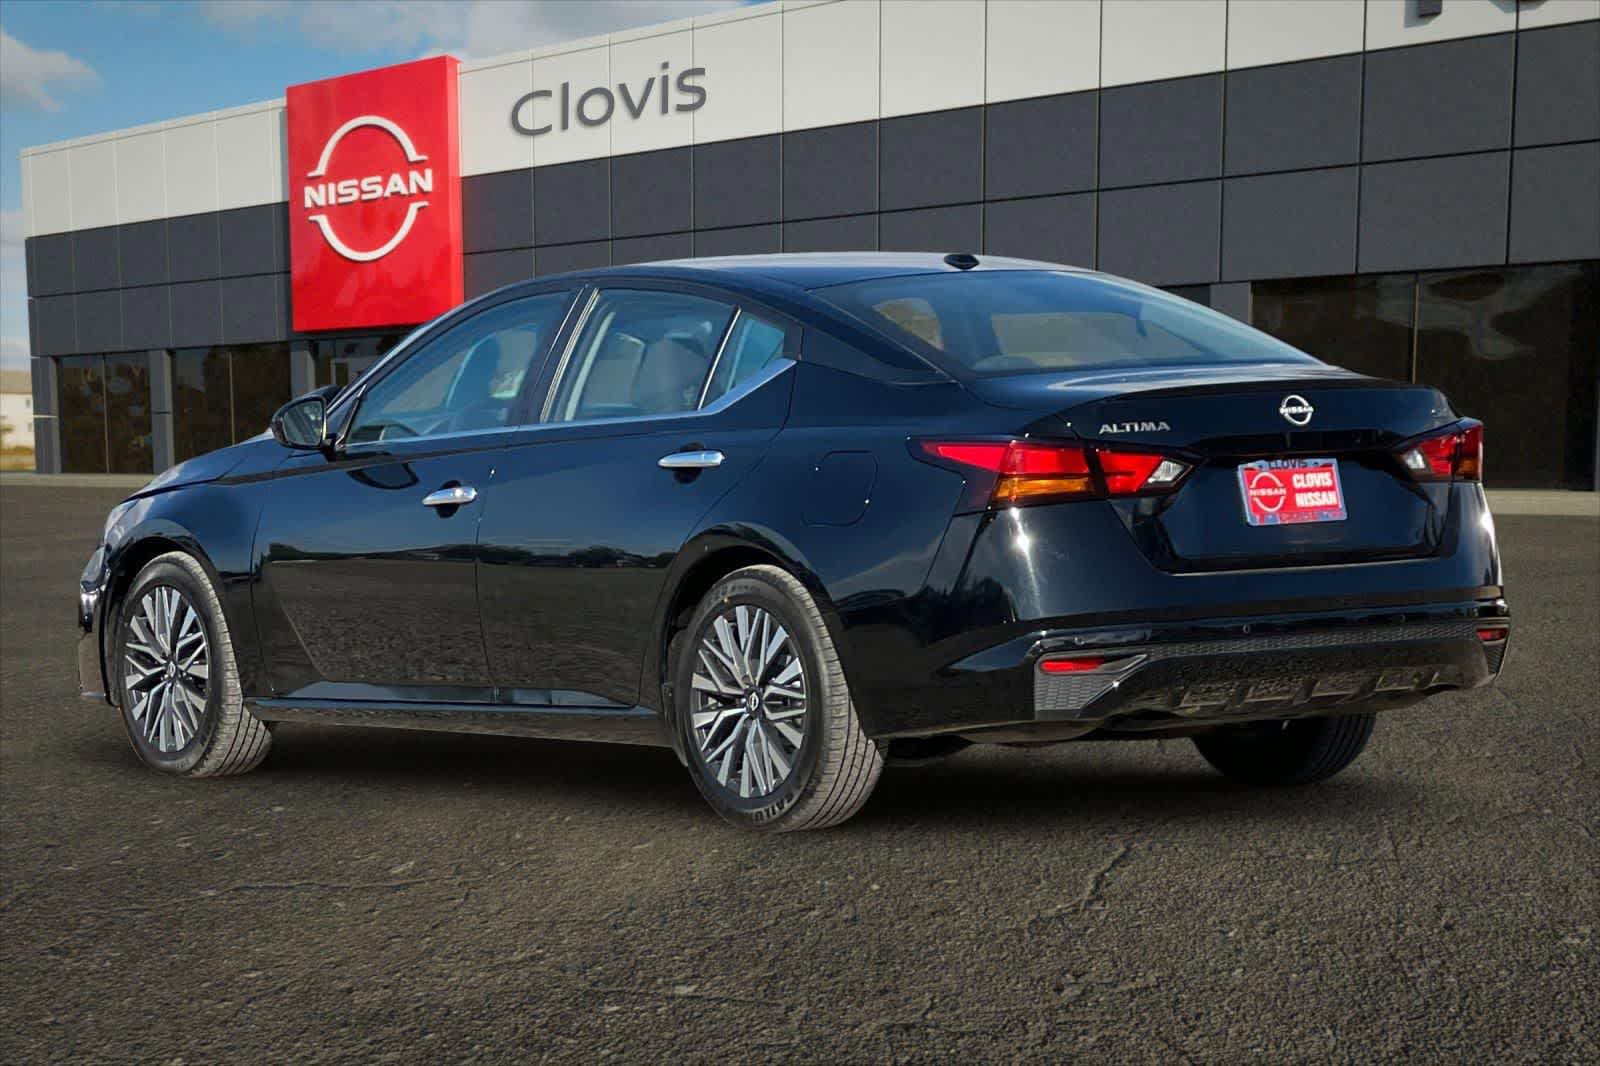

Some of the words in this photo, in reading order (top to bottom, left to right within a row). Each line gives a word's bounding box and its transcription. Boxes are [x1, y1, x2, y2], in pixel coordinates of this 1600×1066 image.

[511, 62, 707, 136] Clovis
[304, 168, 433, 208] NISSAN
[1099, 421, 1171, 434] ALTIMA
[1292, 472, 1333, 489] CLOVIS
[1249, 487, 1287, 497] NISSAN
[1295, 490, 1338, 508] NISSAN
